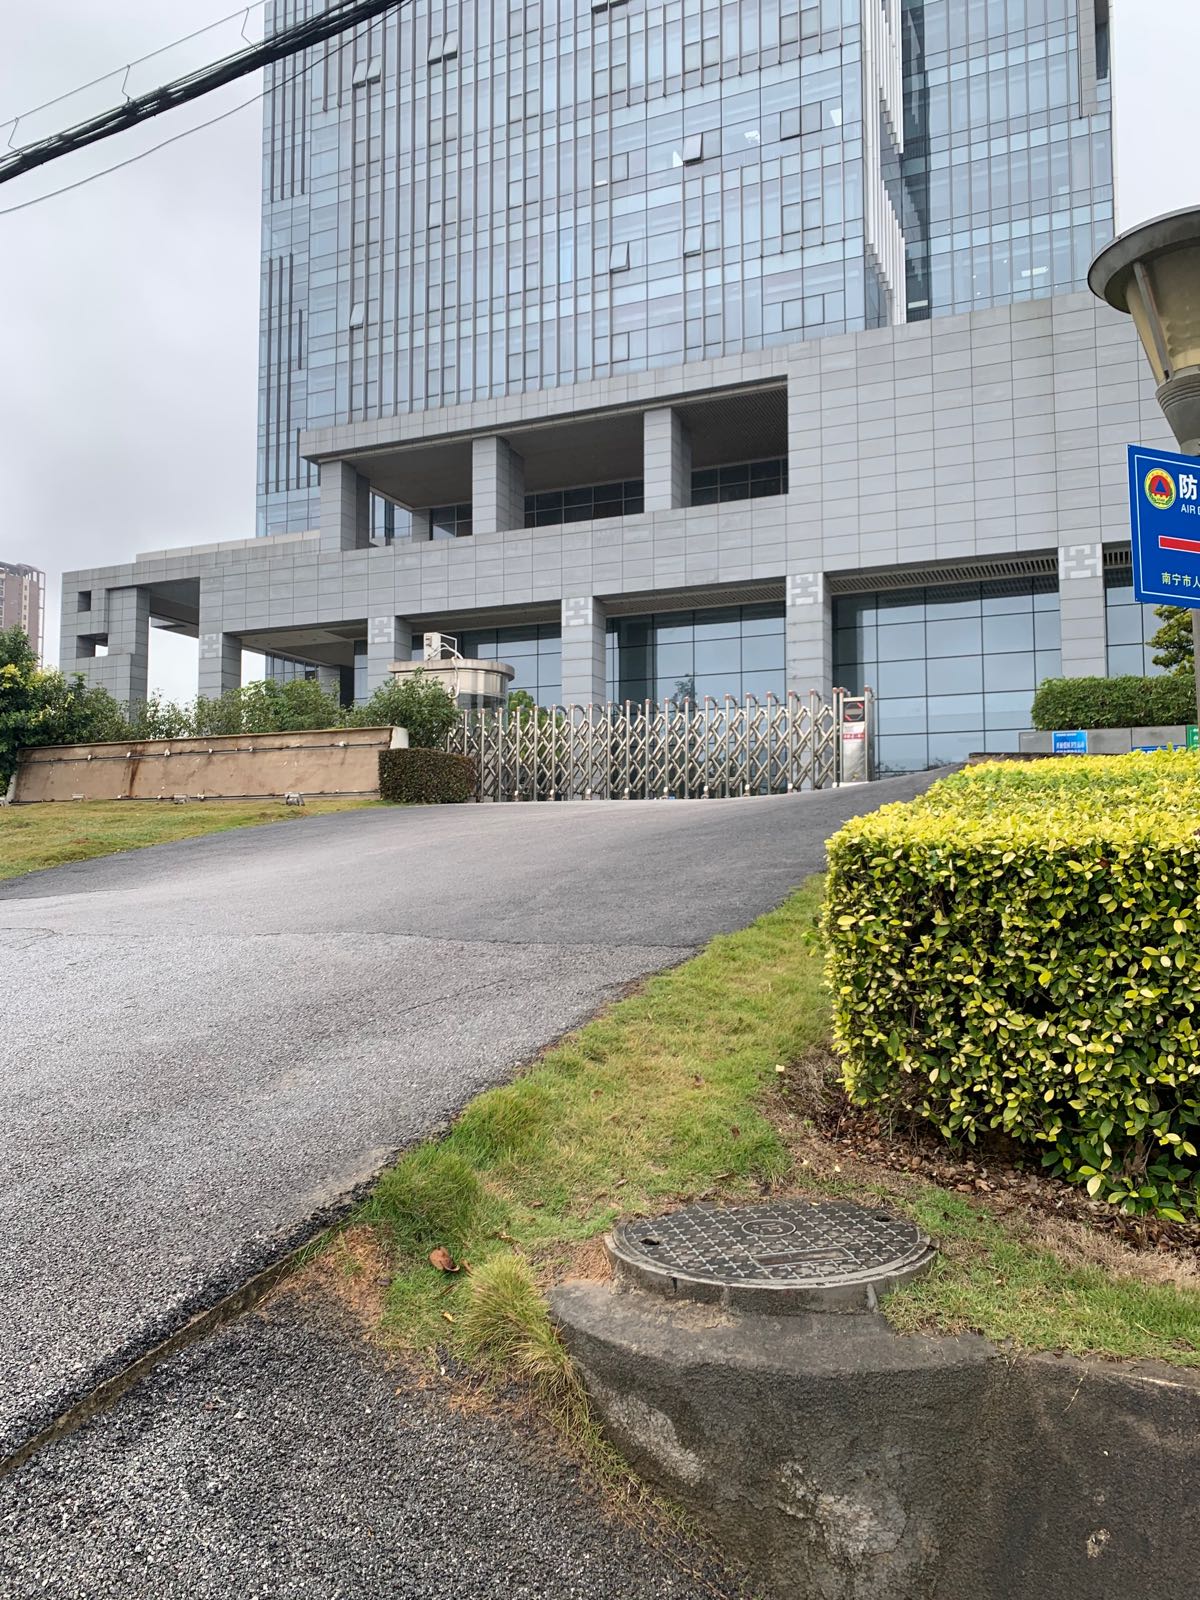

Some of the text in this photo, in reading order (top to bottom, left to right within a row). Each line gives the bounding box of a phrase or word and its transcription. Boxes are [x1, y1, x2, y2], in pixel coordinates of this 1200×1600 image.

[1179, 474, 1198, 500] 防
[1181, 504, 1196, 515] AIR
[1161, 571, 1200, 588] 南宁市人
